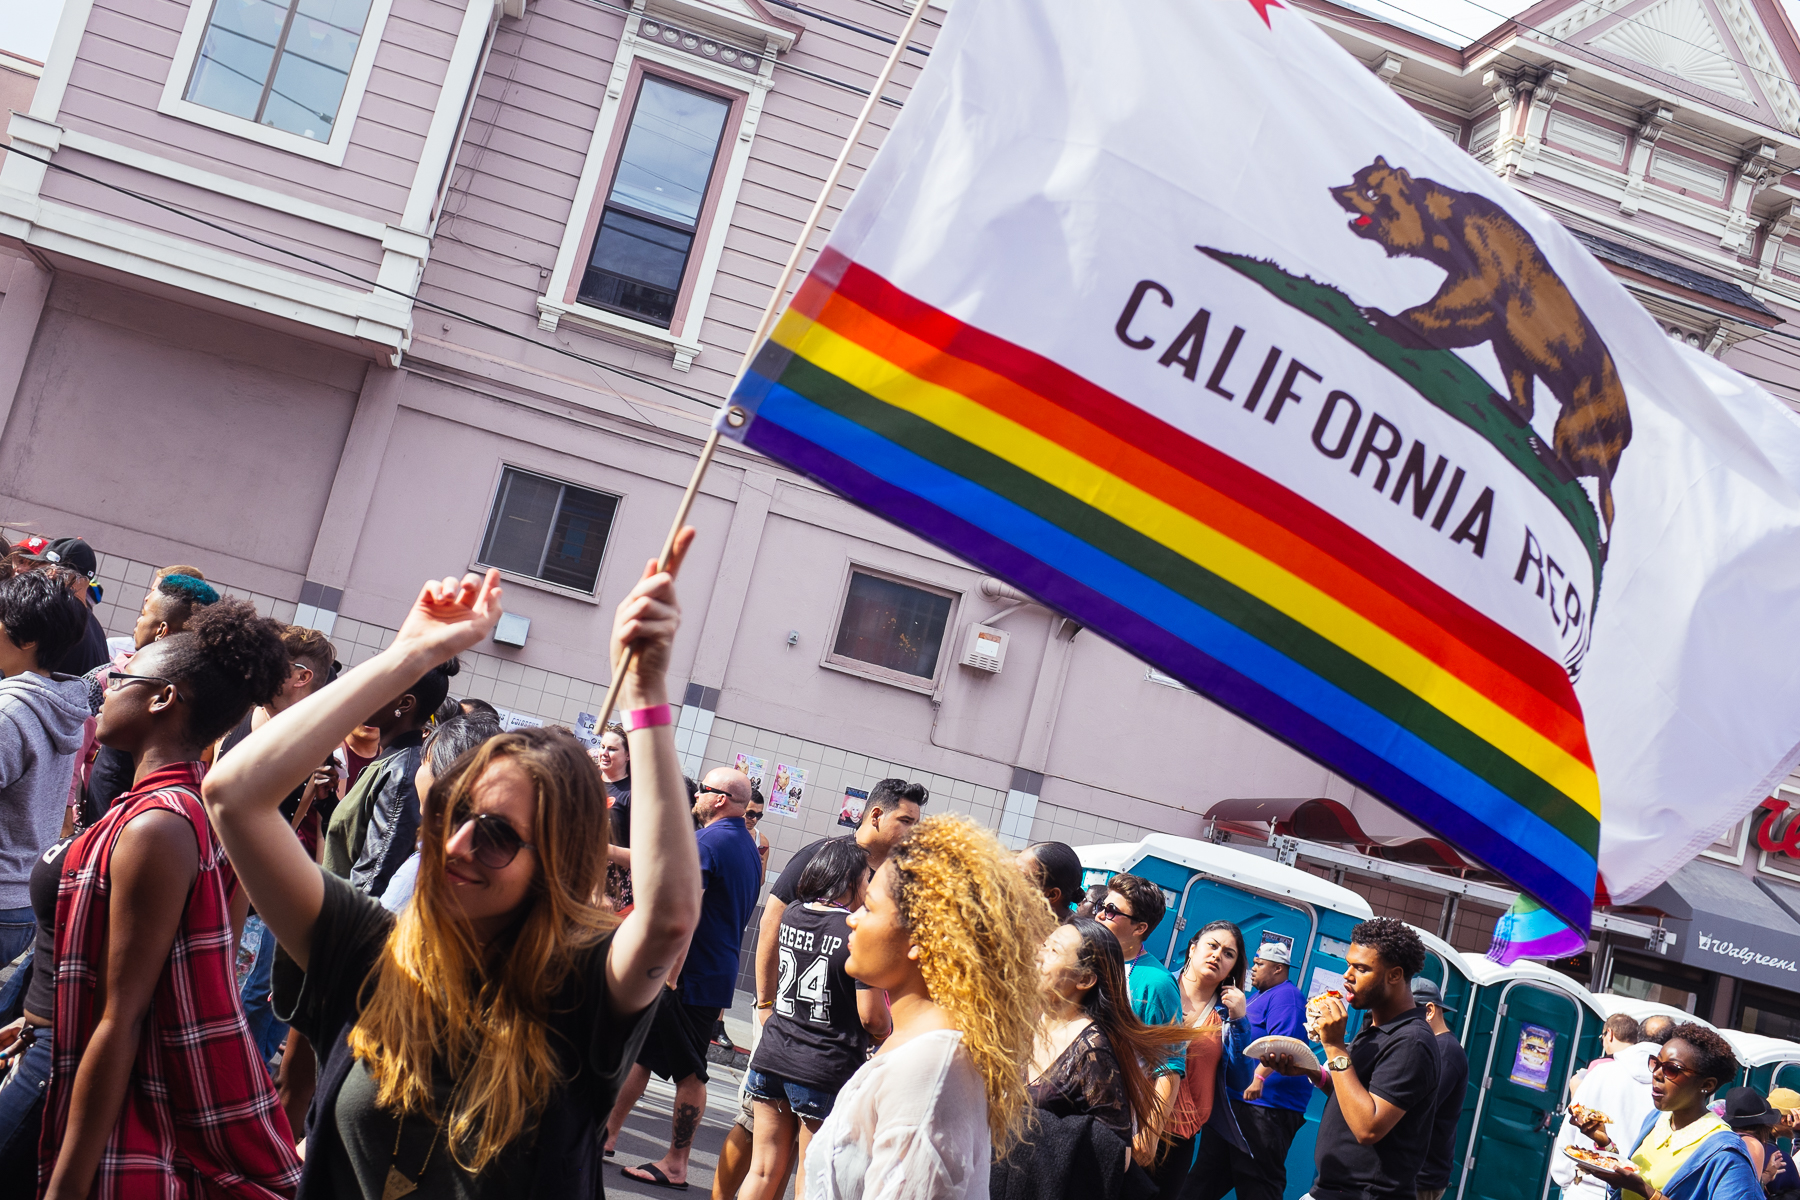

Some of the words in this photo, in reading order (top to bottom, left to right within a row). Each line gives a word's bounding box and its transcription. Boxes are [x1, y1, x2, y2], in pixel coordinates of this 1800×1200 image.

[1115, 280, 1495, 559] CALIFORNIA
[821, 935, 842, 956] UP
[1711, 938, 1798, 973] Walgreens
[776, 945, 831, 1024] 24
